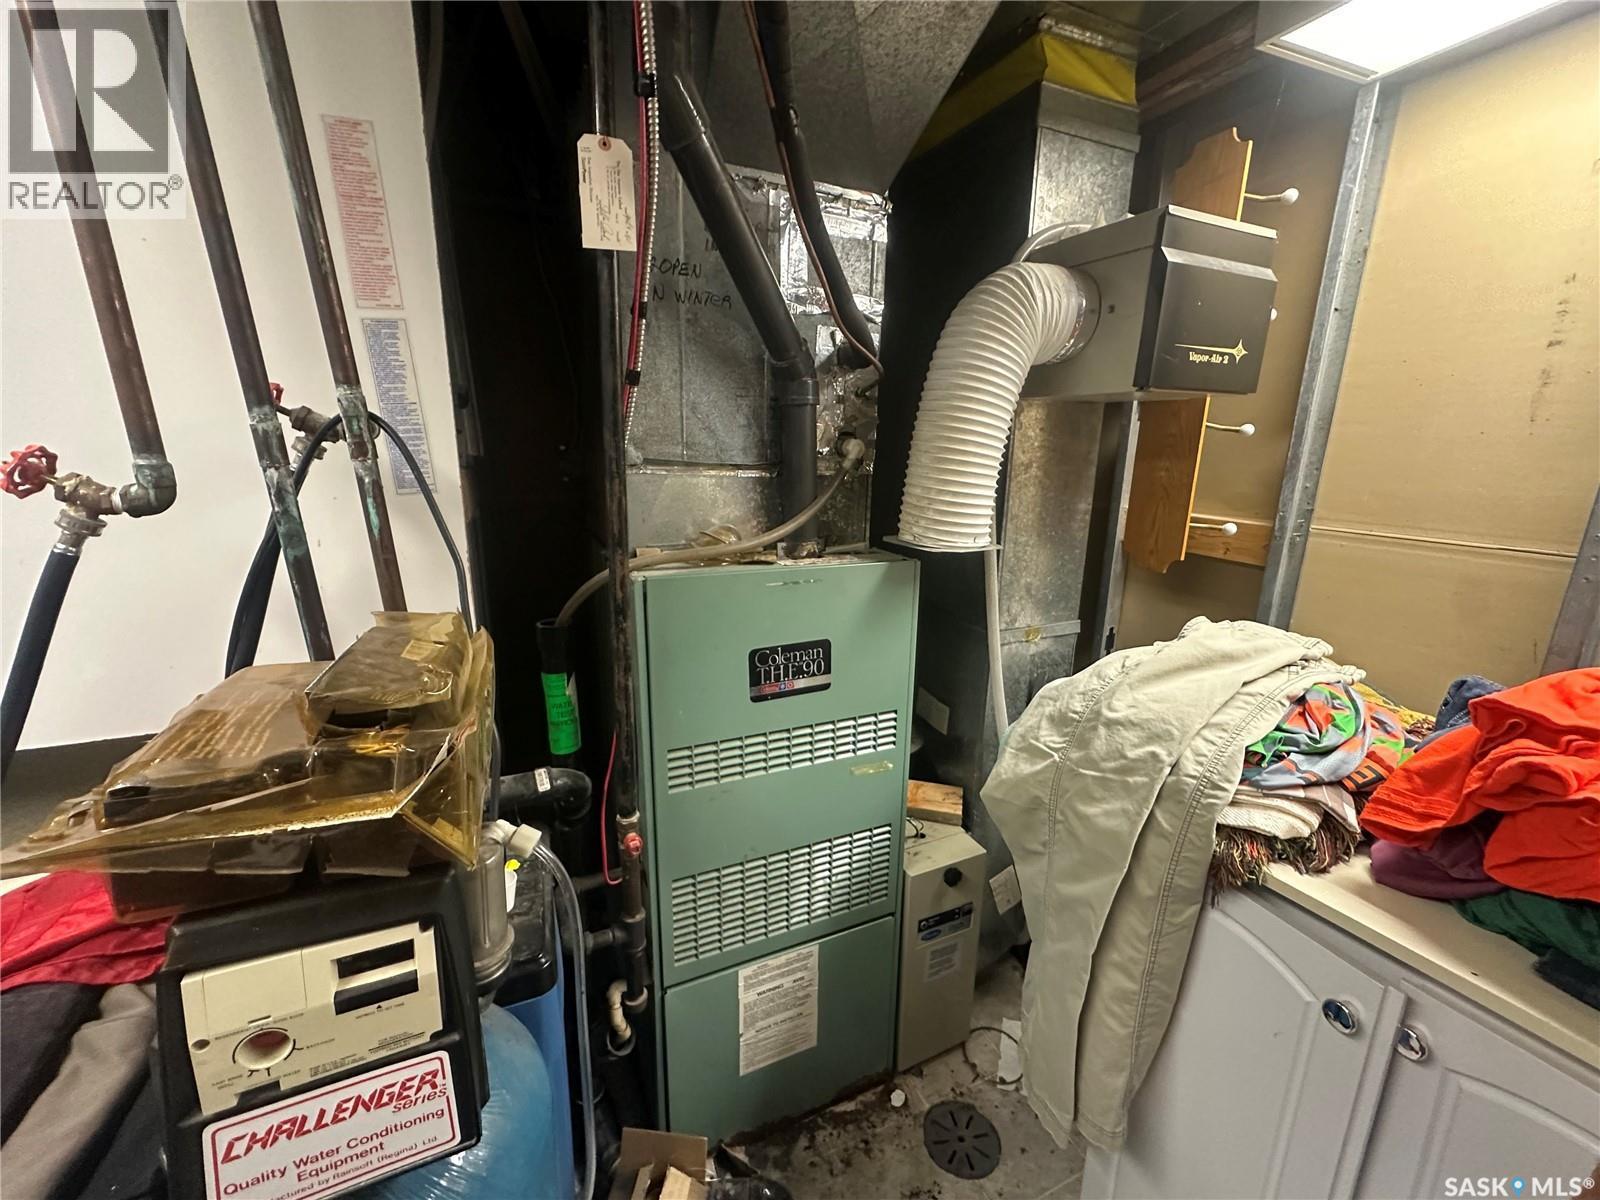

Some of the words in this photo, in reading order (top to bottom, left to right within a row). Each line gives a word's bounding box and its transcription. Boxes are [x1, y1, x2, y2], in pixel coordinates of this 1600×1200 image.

[1222, 355, 1229, 364] 2
[755, 647, 823, 668] Coleman
[392, 1086, 447, 1114] series
[221, 1068, 440, 1164] CHALLENGER
[224, 1165, 288, 1195] Quality
[293, 1146, 342, 1169] Water
[346, 1108, 445, 1149] Conditioning
[297, 1141, 385, 1182] Equipment
[318, 1176, 331, 1186] by
